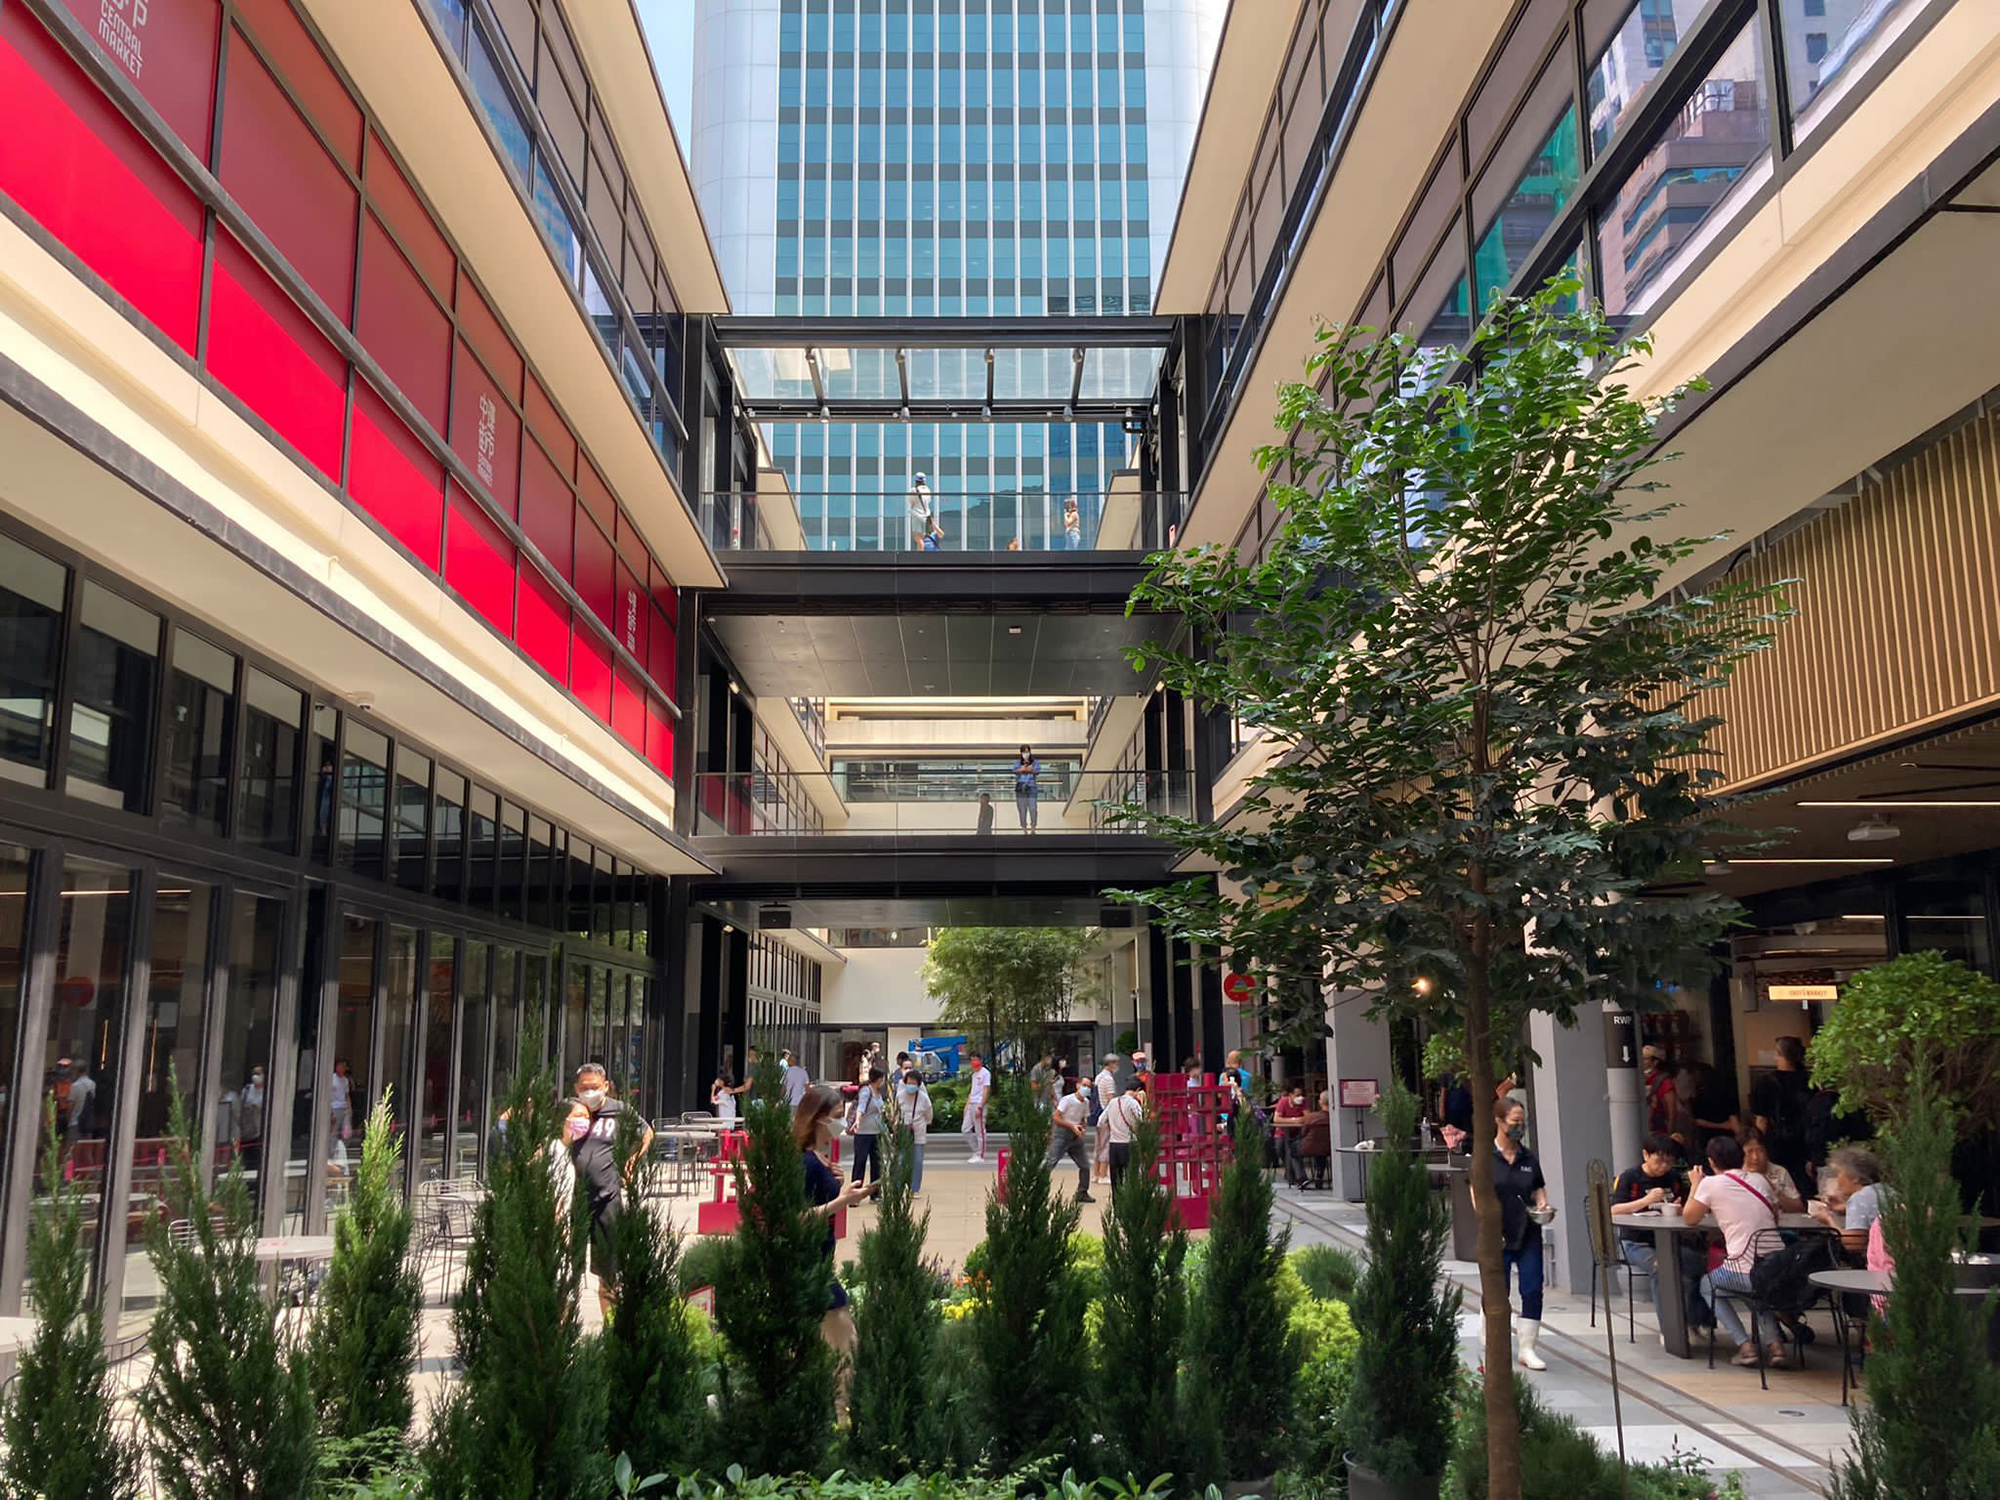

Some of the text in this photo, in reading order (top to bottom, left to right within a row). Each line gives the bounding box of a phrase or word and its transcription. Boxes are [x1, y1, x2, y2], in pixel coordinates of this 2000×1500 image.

[98, 18, 143, 79] MARKET
[101, 0, 143, 61] CENTRAL
[1613, 1015, 1632, 1025] RWP
[592, 1117, 616, 1137] 49
